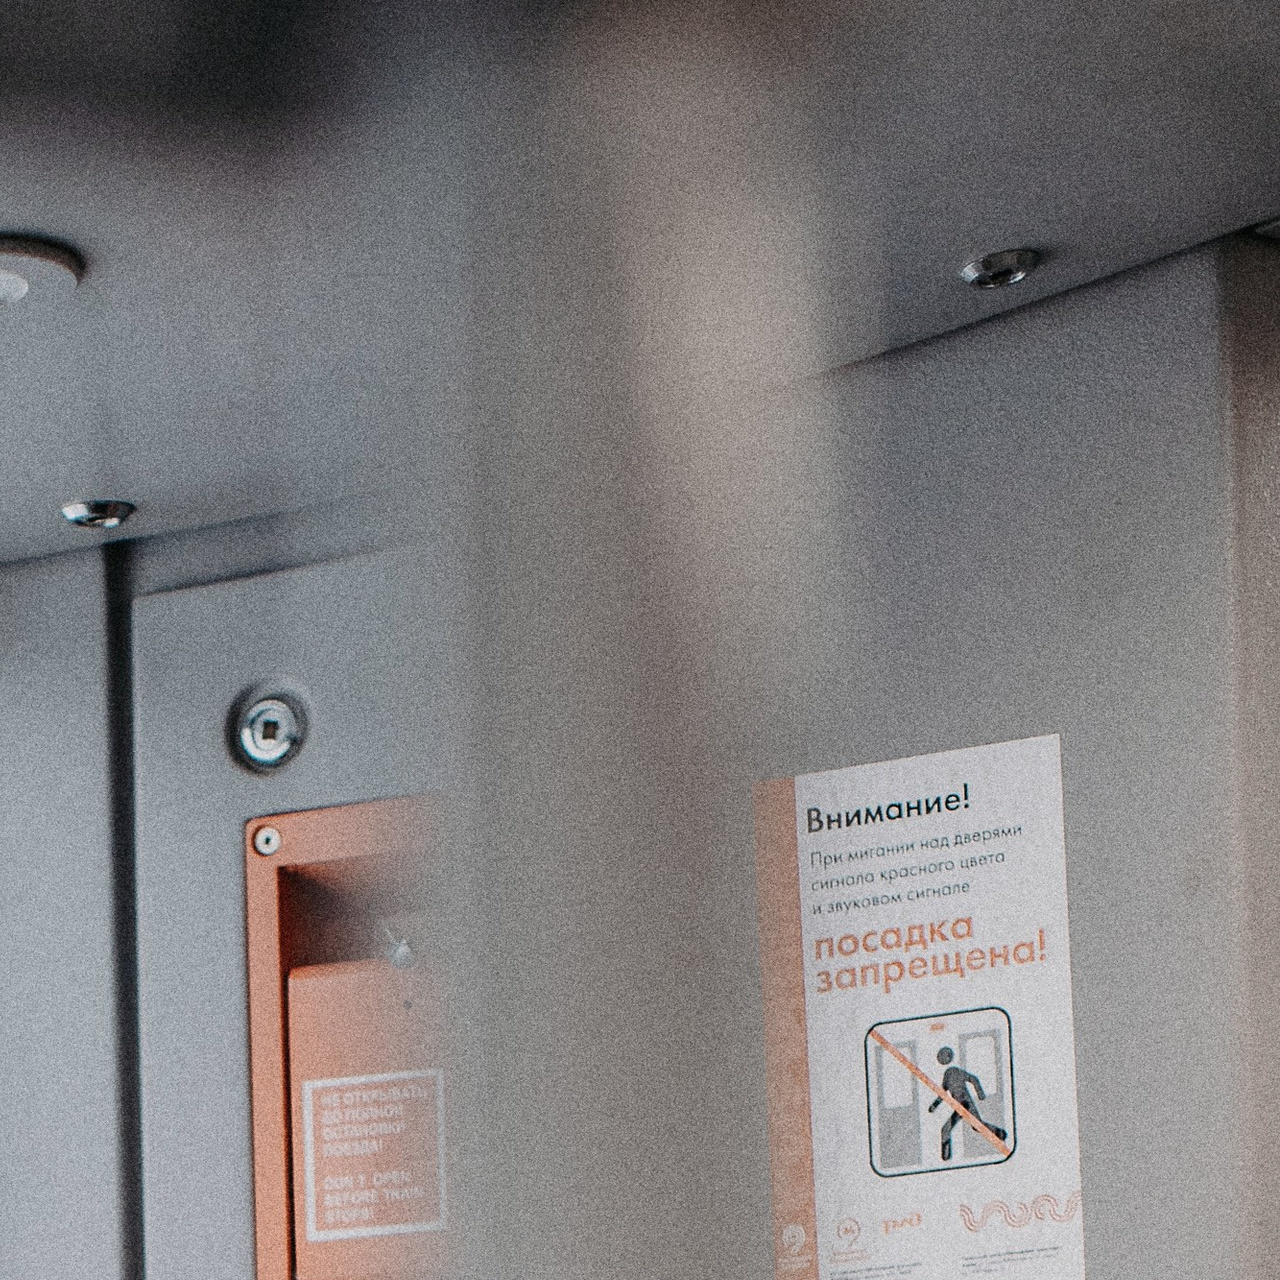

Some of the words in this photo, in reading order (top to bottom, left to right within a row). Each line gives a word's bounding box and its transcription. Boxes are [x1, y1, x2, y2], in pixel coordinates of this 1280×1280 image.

[806, 783, 971, 834] Внимание!
[810, 850, 844, 873] При
[847, 842, 915, 864] мигании
[920, 836, 951, 853] над
[953, 824, 1023, 849] дверями
[810, 870, 875, 892] сигнала
[879, 859, 955, 886] красного
[959, 850, 1006, 873] цвета
[812, 902, 823, 916] и
[826, 891, 903, 916] звуковом
[907, 880, 971, 902] сигнале
[815, 916, 974, 962] посадка
[815, 928, 1047, 995] запрещена!
